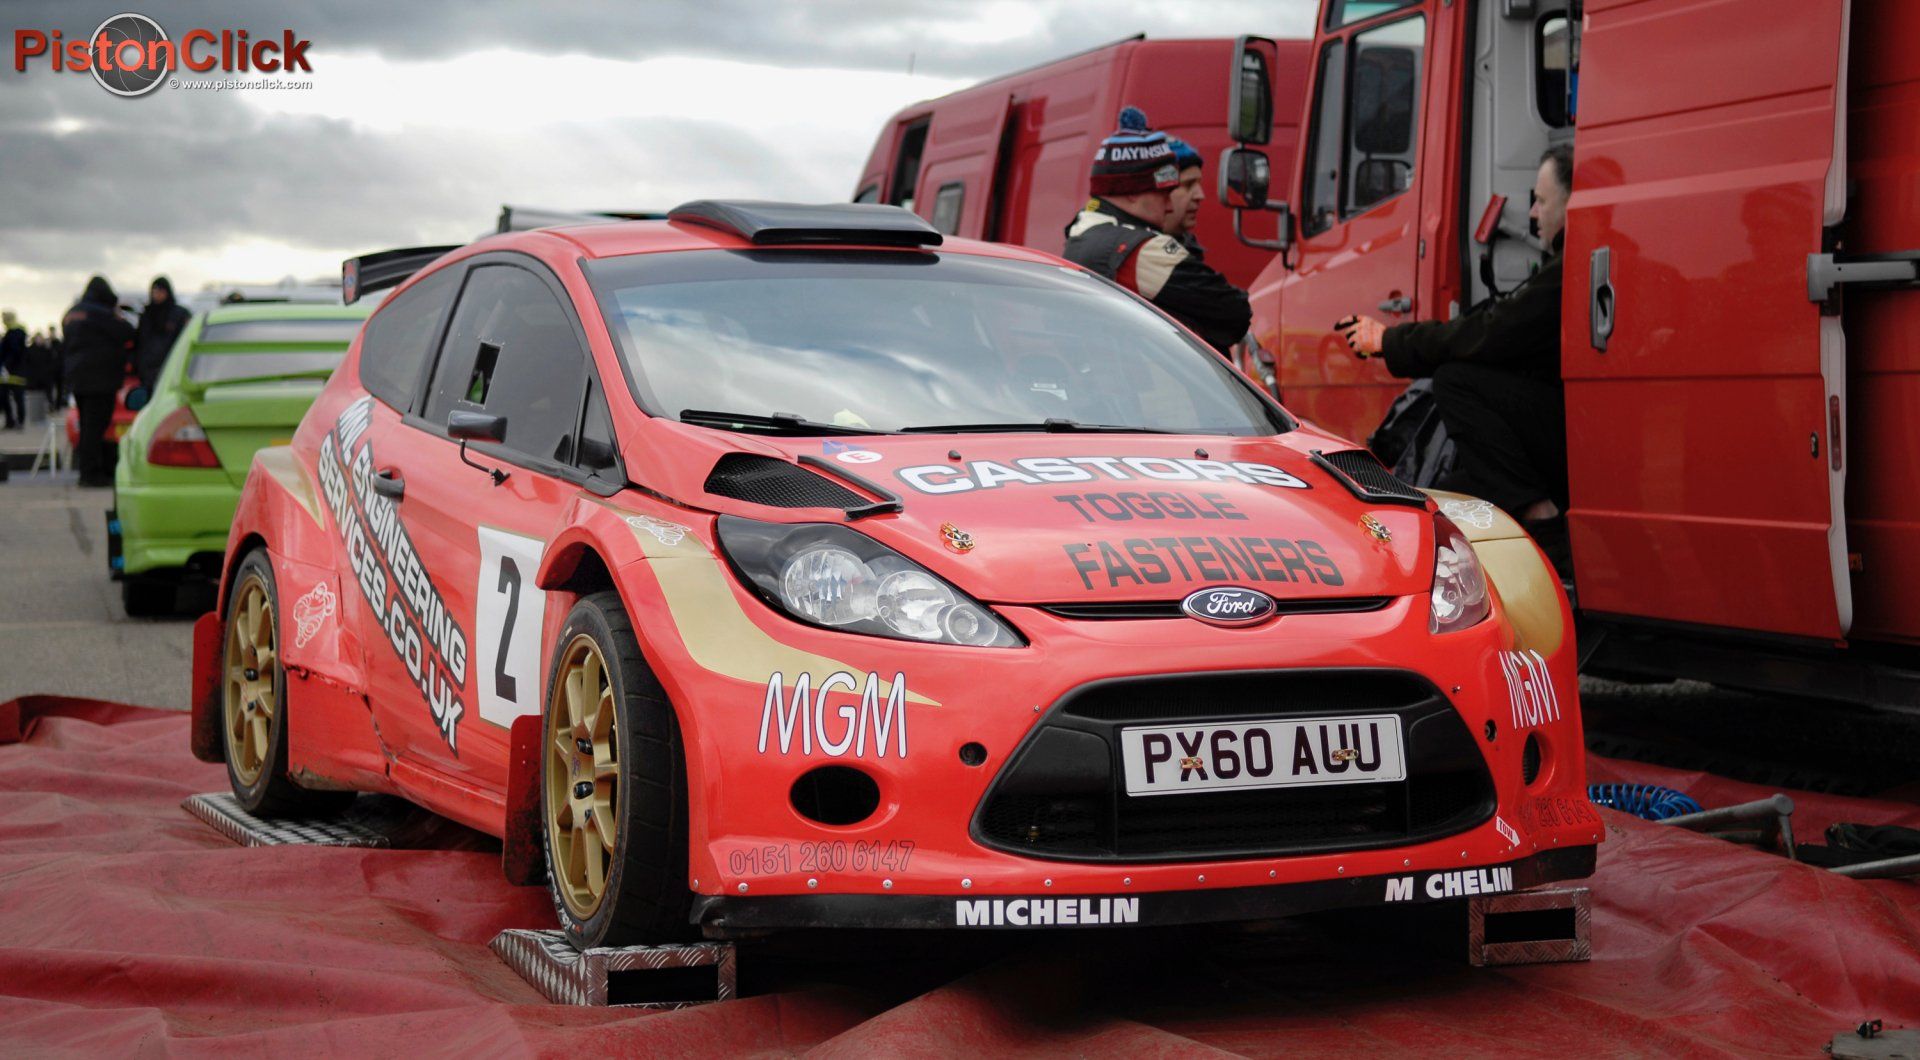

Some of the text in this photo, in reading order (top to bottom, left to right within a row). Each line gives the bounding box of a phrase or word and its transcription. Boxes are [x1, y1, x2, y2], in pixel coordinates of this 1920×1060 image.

[897, 456, 1309, 493] CASTORS
[1055, 492, 1249, 523] TOGGLE
[318, 430, 464, 754] SERVICES.CO.UK
[352, 440, 466, 690] ENGINEERING
[1063, 537, 1345, 591] FASTENERS
[495, 555, 522, 704] 2
[1206, 592, 1256, 614] Ford
[757, 671, 908, 759] MGM
[1498, 648, 1561, 730] MGM
[1142, 722, 1383, 785] PX60 AUU
[729, 840, 916, 876] 0151 260 6147
[955, 897, 1139, 926] MICHELIN
